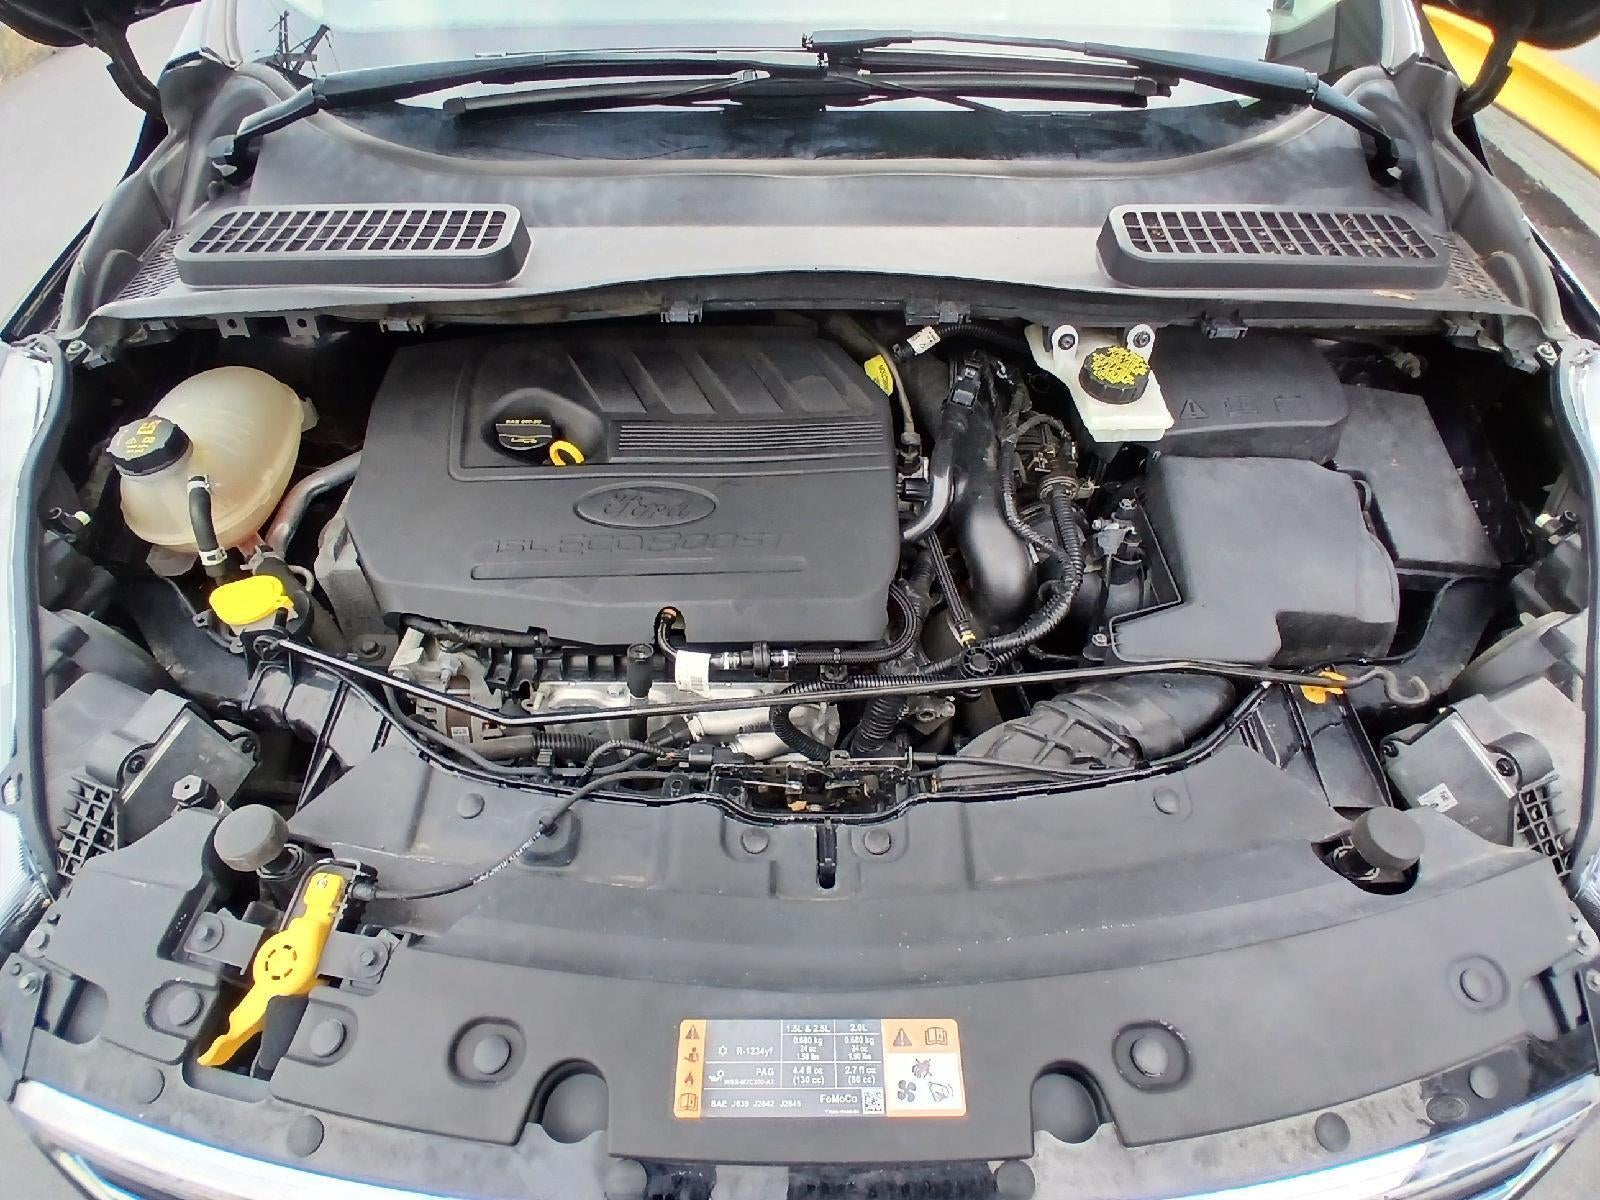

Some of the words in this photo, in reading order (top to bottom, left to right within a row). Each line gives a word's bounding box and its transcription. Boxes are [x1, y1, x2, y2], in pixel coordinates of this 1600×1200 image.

[603, 492, 690, 519] Ford
[849, 1023, 868, 1032] 2.0L
[813, 1036, 823, 1046] kg
[864, 1036, 874, 1046] kg
[736, 1046, 774, 1057] R-1234yf
[755, 1067, 775, 1076] PAG
[844, 1065, 858, 1075] 2.7
[792, 1075, 810, 1085] (130
[811, 1075, 825, 1085] cc)
[862, 1075, 876, 1085] cc)
[819, 1093, 858, 1104] FoMoCo
